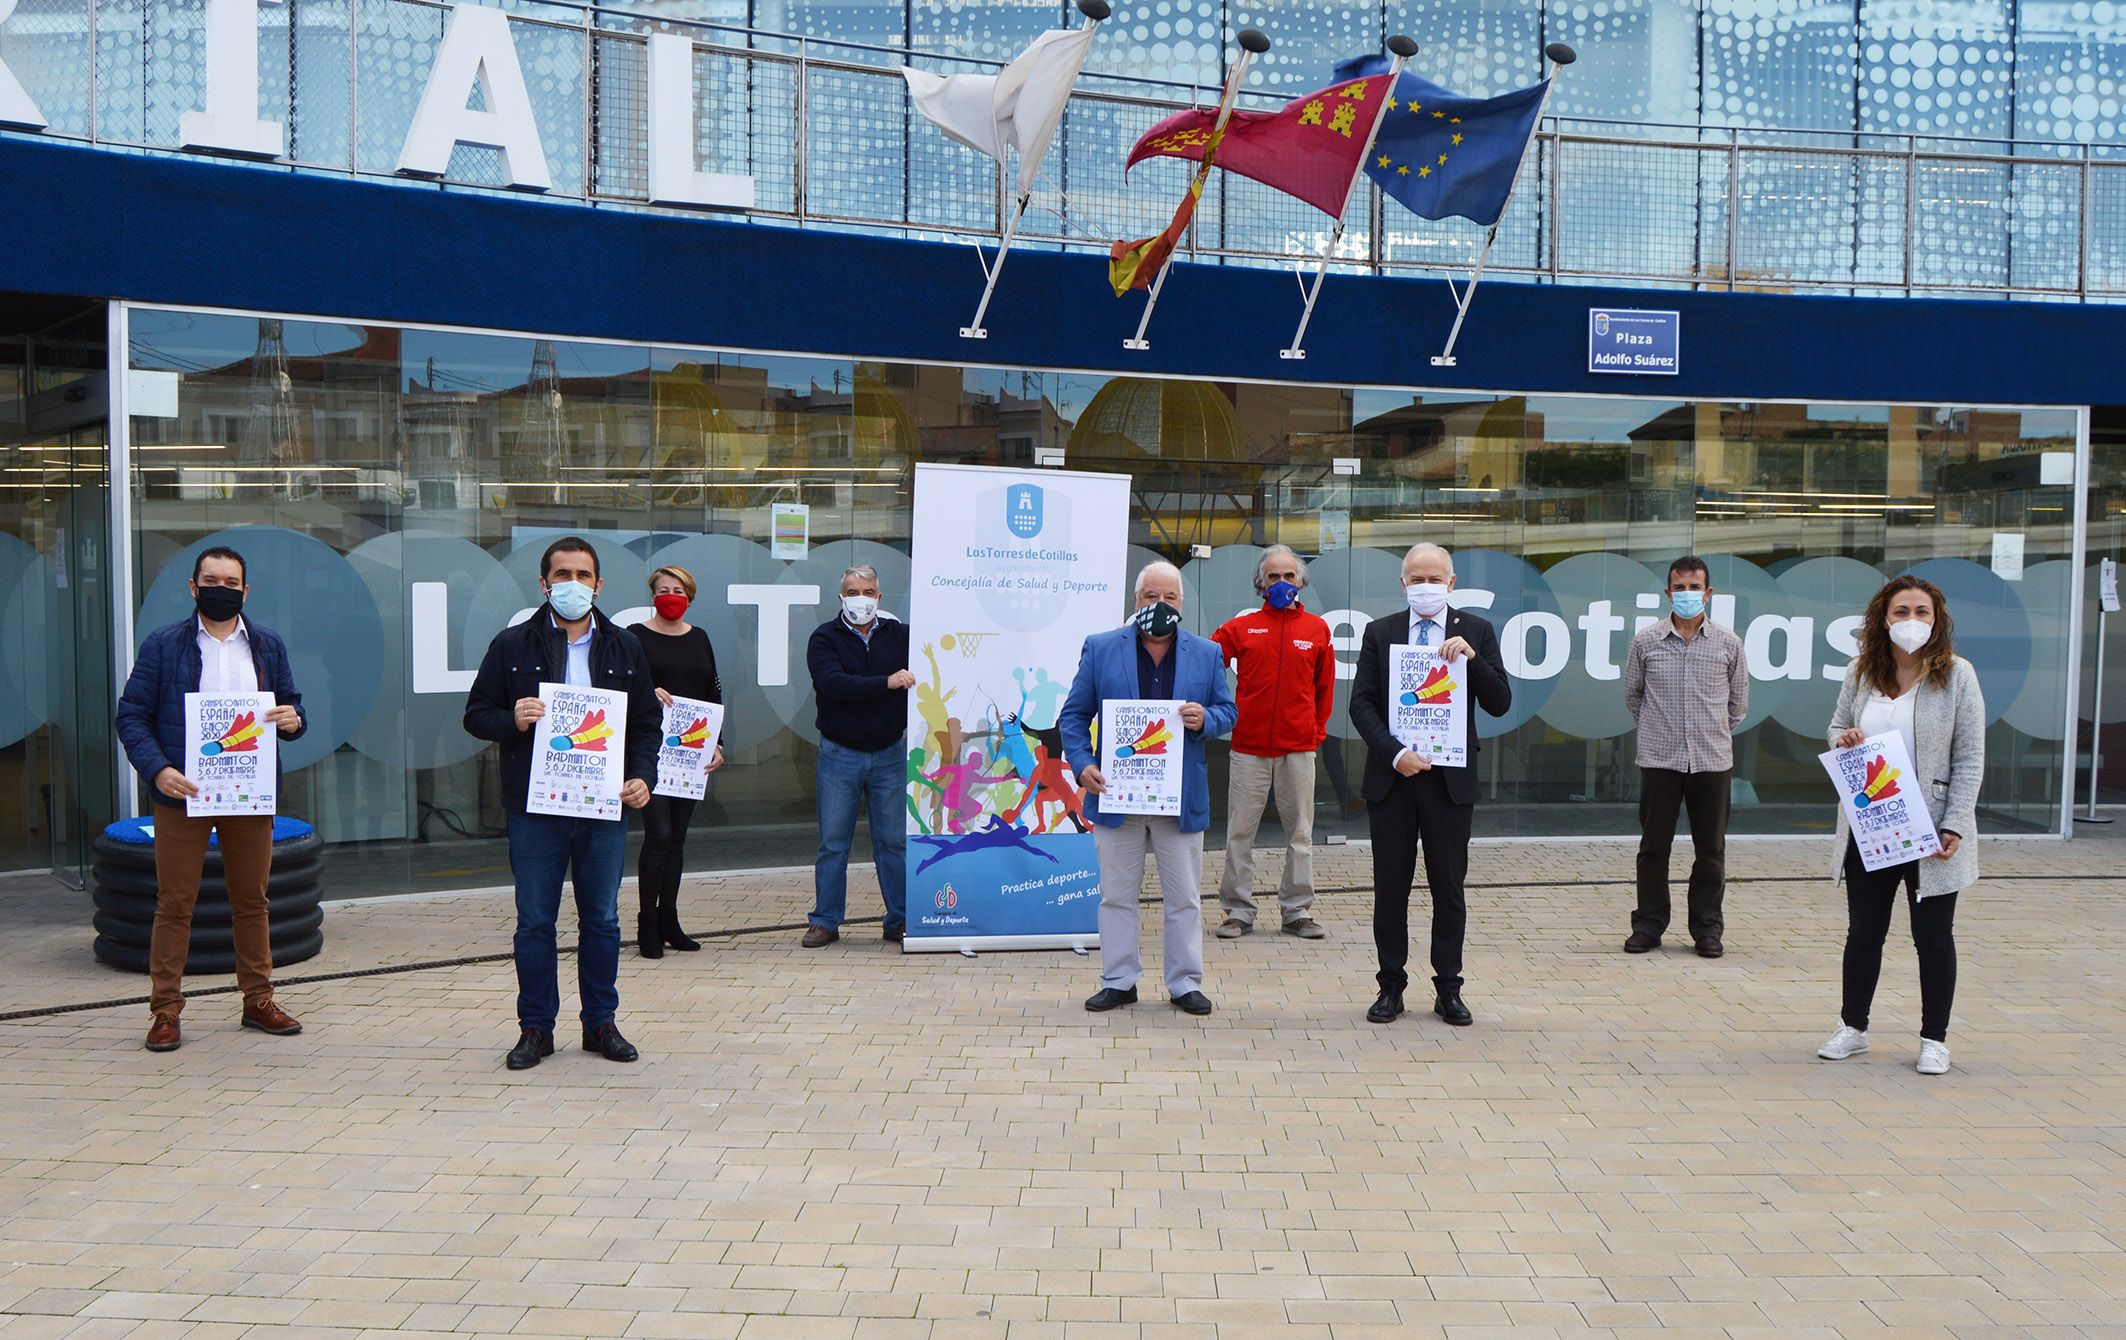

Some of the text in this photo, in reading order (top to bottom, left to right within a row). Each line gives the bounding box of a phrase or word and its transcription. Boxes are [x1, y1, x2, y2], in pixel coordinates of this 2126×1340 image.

[1616, 332, 1653, 344] Plaza
[1594, 353, 1674, 366] Adolfo Suárez
[931, 575, 1108, 594] Concejalía de Salud y Deporte
[1401, 681, 1417, 690] 2020
[200, 699, 259, 707] CAMPEONATOS
[554, 691, 611, 705] CAMPEONATOS
[1116, 706, 1170, 714] CAMPEONATOS
[1398, 706, 1450, 718] BADMINTON
[552, 714, 579, 726] SENIOR
[201, 722, 230, 731] SENIOR
[551, 724, 571, 733] 2020
[201, 731, 220, 740] 2020
[1116, 728, 1142, 737] SENIOR
[1116, 736, 1134, 744] 2020
[199, 756, 257, 767] BADMINTON
[546, 750, 606, 766] BADMINTON
[1113, 758, 1166, 768] BADMINTON
[219, 766, 255, 774] DICIEMBRE
[567, 764, 604, 775] DICIEMBRE
[1856, 798, 1906, 820] BADMINTON
[1001, 870, 1096, 895] Practica deporte...
[1057, 891, 1083, 905] gana
[946, 916, 969, 925] Deporte
